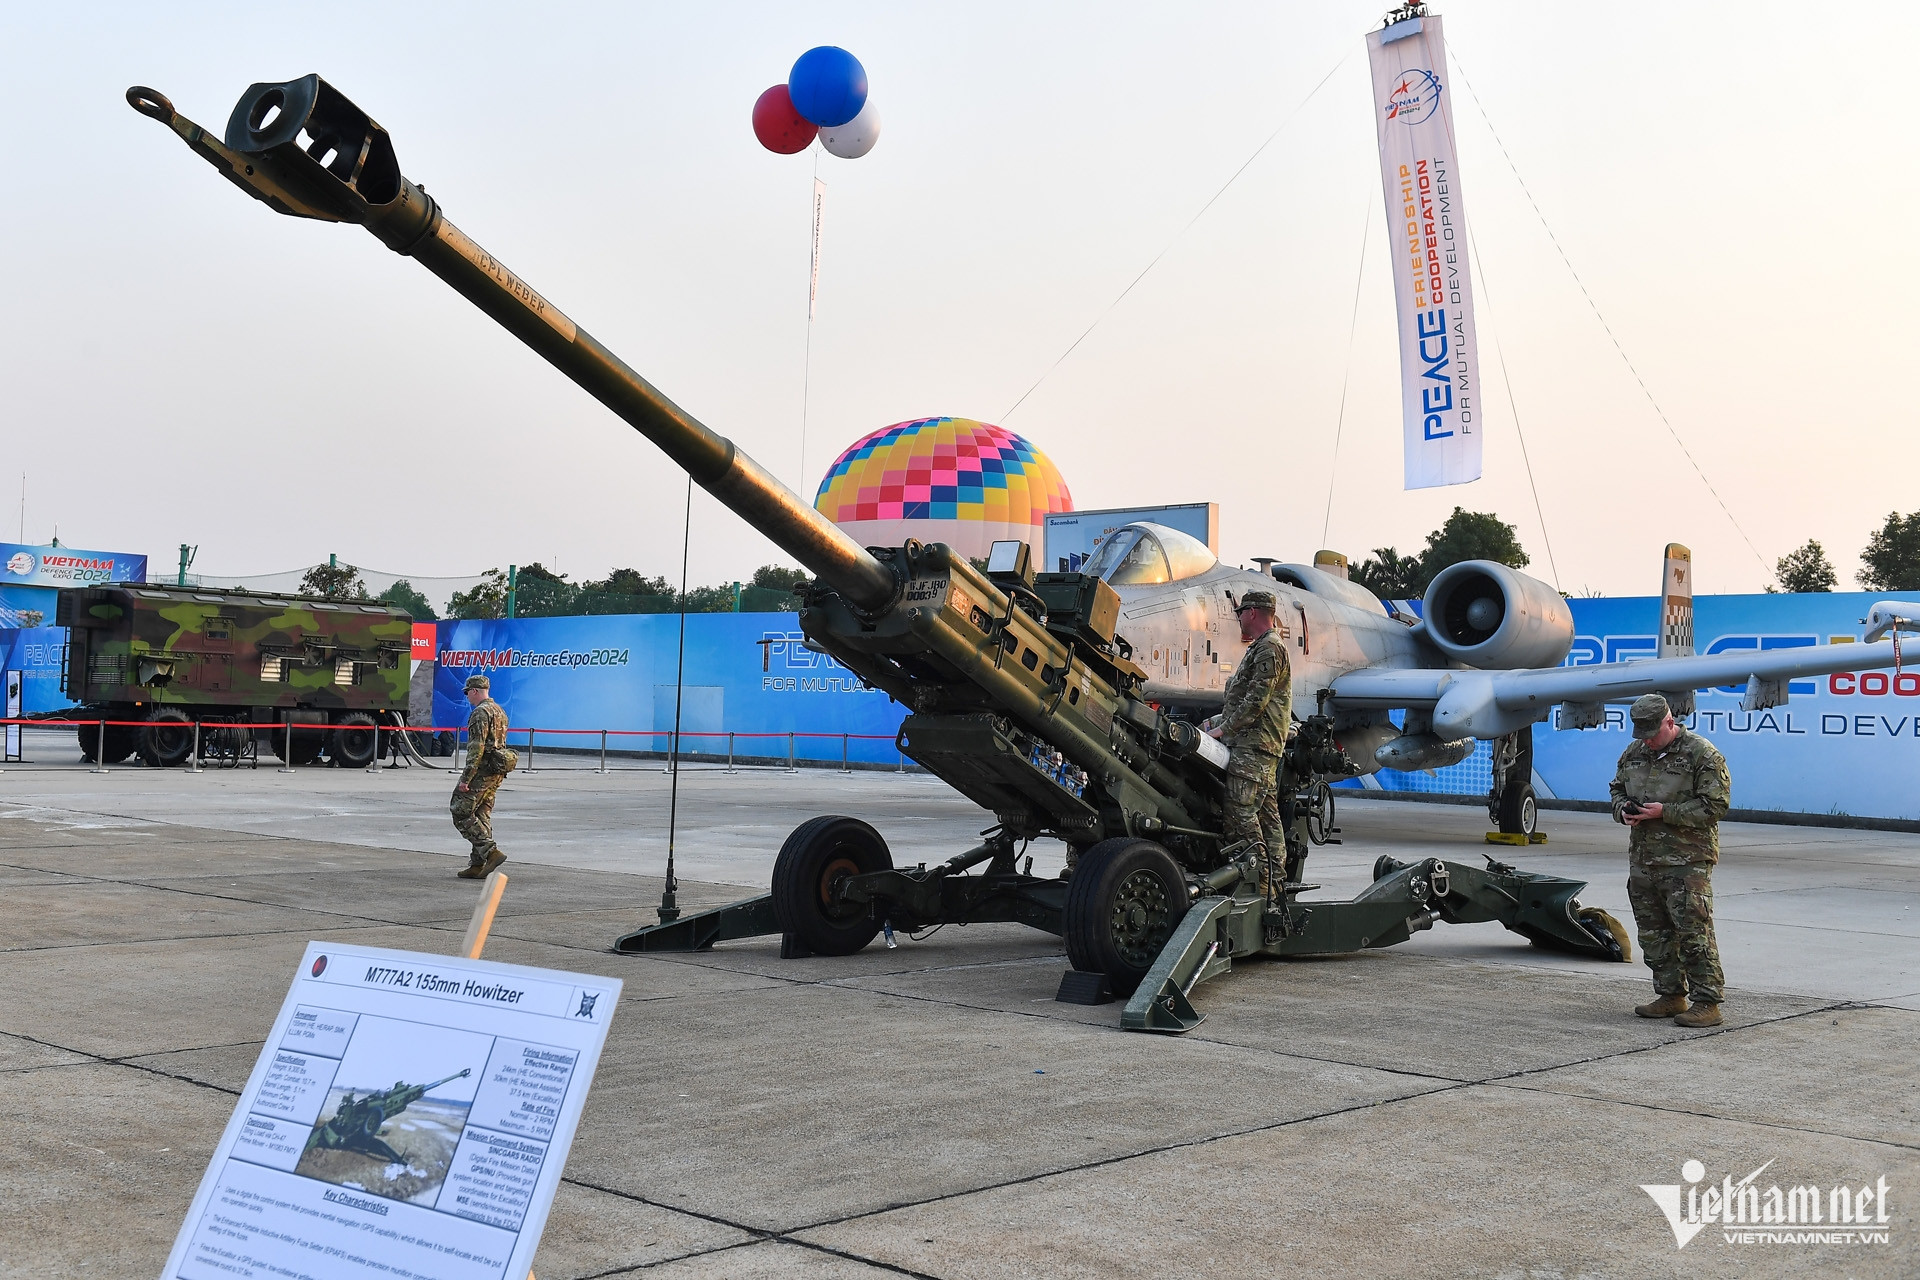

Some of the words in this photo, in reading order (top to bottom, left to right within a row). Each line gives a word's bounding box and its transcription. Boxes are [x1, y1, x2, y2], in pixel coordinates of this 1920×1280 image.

[1399, 164, 1427, 308] FRIENDSHIP
[1416, 159, 1444, 304] COOPERATION
[1434, 157, 1462, 304] DEVELOPMENT
[506, 273, 545, 314] WEBER
[1453, 310, 1469, 390] MUTUAL
[1417, 308, 1454, 441] PEACE
[1461, 397, 1472, 434] FOR
[1050, 518, 1079, 526] Sacombank
[40, 567, 73, 575] DEFENCE
[42, 555, 115, 571] VIETNAM
[72, 568, 112, 582] 2024
[762, 676, 796, 692] FOR
[801, 676, 876, 693] MUTUA
[364, 966, 413, 987] M777A2
[416, 973, 461, 994] 155mm
[462, 980, 525, 1004] Howitzer
[275, 1053, 306, 1066] Specifications
[522, 1047, 540, 1058] Firing
[539, 1051, 573, 1064] Information
[524, 1058, 549, 1069] Effective
[502, 1065, 517, 1073] 24km
[517, 1068, 528, 1076] (HE
[493, 1074, 508, 1082] 30km
[508, 1077, 520, 1085] (HE
[519, 1079, 539, 1089] Rocket
[520, 1101, 535, 1112] Rate
[534, 1105, 543, 1113] of
[531, 1092, 560, 1105] (Excalibur)
[509, 1110, 529, 1120] Normal
[539, 1116, 554, 1125] RPM
[499, 1119, 525, 1130] Maximum
[530, 1125, 535, 1133] 5
[535, 1126, 550, 1136] RPM
[465, 1130, 488, 1143] Mission
[487, 1135, 518, 1150] Command
[517, 1142, 543, 1155] Systems
[488, 1146, 520, 1159] SINCGARS
[520, 1153, 540, 1164] RADIO
[469, 1153, 488, 1163] (Digital
[488, 1157, 499, 1166] Fire
[499, 1160, 520, 1171] Mission
[521, 1165, 537, 1176] Data)
[453, 1173, 472, 1182] system
[472, 1177, 493, 1187] location
[494, 1183, 505, 1191] and
[505, 1185, 529, 1198] targeting
[495, 1171, 521, 1183] (Provides
[521, 1178, 533, 1186] gun
[322, 1189, 338, 1202] Key
[336, 1192, 389, 1216] Characteristics
[459, 1186, 489, 1198] coordinates
[490, 1192, 498, 1200] for
[498, 1194, 526, 1208] Excalibur)
[456, 1195, 469, 1205] MSE
[513, 1209, 522, 1218] fire
